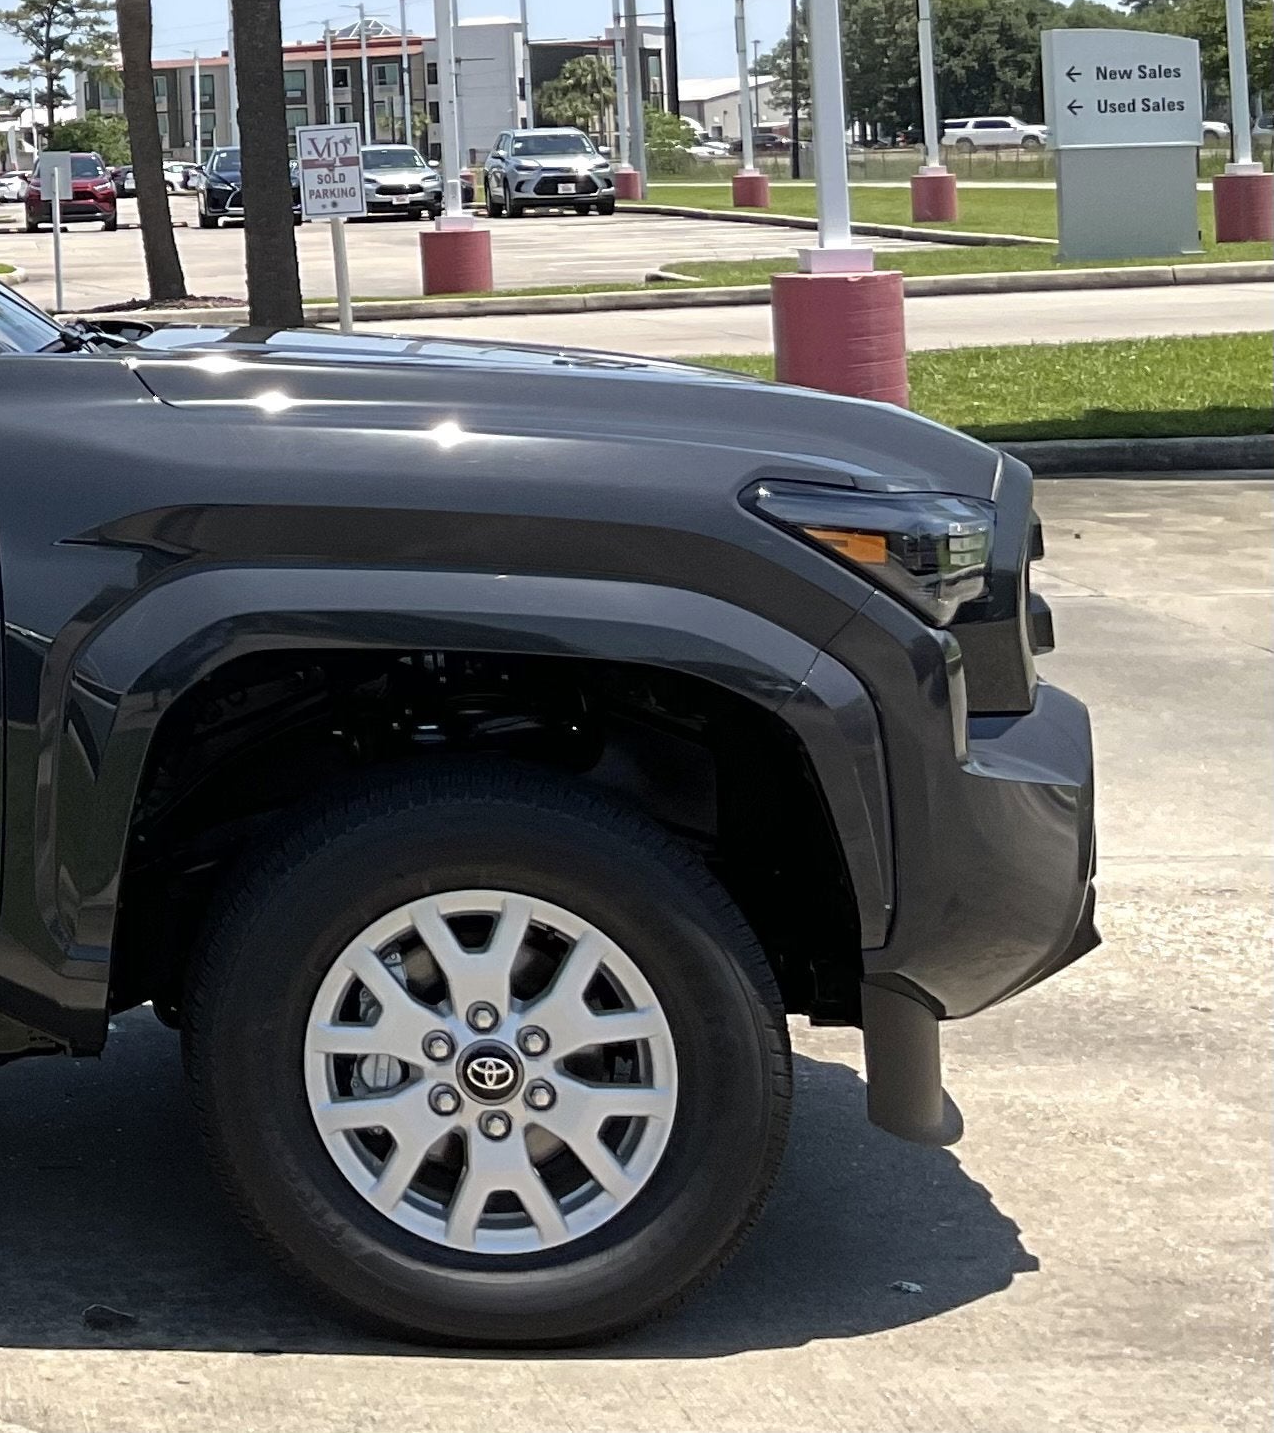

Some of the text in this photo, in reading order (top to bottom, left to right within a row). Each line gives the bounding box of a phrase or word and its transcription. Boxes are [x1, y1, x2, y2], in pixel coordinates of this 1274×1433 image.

[1096, 65, 1181, 80] New Sales
[1097, 97, 1185, 113] Used Sales
[317, 173, 346, 184] SOLD
[309, 187, 356, 199] PARKING
